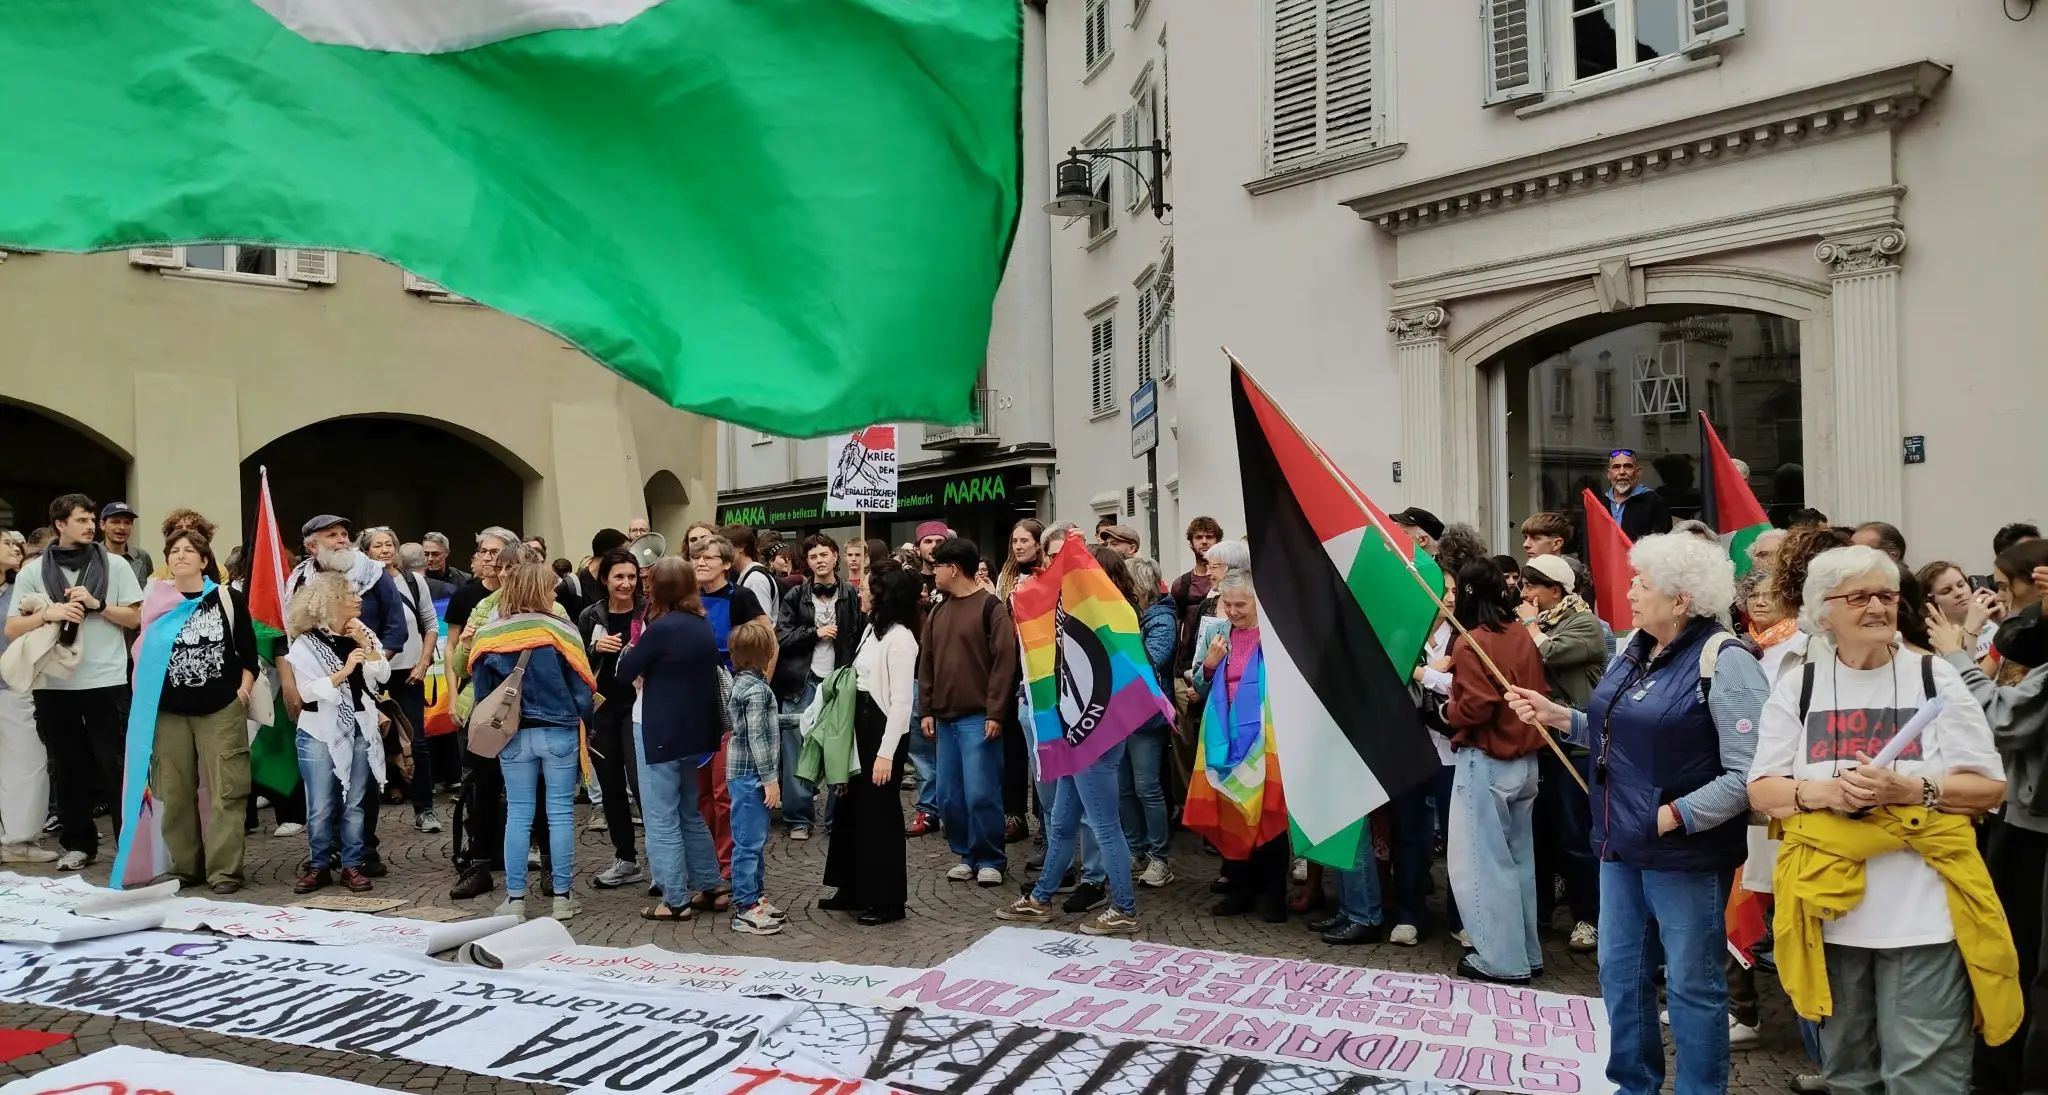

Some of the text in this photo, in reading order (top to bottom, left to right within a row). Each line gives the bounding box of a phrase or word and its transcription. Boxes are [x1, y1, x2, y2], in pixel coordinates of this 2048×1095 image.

[879, 466, 895, 474] DEM
[943, 474, 1006, 506] MARKA
[725, 505, 766, 526] MARKA
[792, 508, 817, 519] bellezza
[896, 493, 933, 508] erieMarkt
[1826, 709, 1867, 735] NO
[1810, 736, 1920, 760] GUERA
[221, 954, 367, 976] notte
[368, 969, 426, 987] la
[739, 984, 781, 994] SIND
[810, 972, 888, 989] ABER
[783, 983, 823, 999] WIR
[886, 970, 1060, 1017] CON
[1492, 1019, 1597, 1054] LA
[486, 1016, 760, 1093] LOTTA
